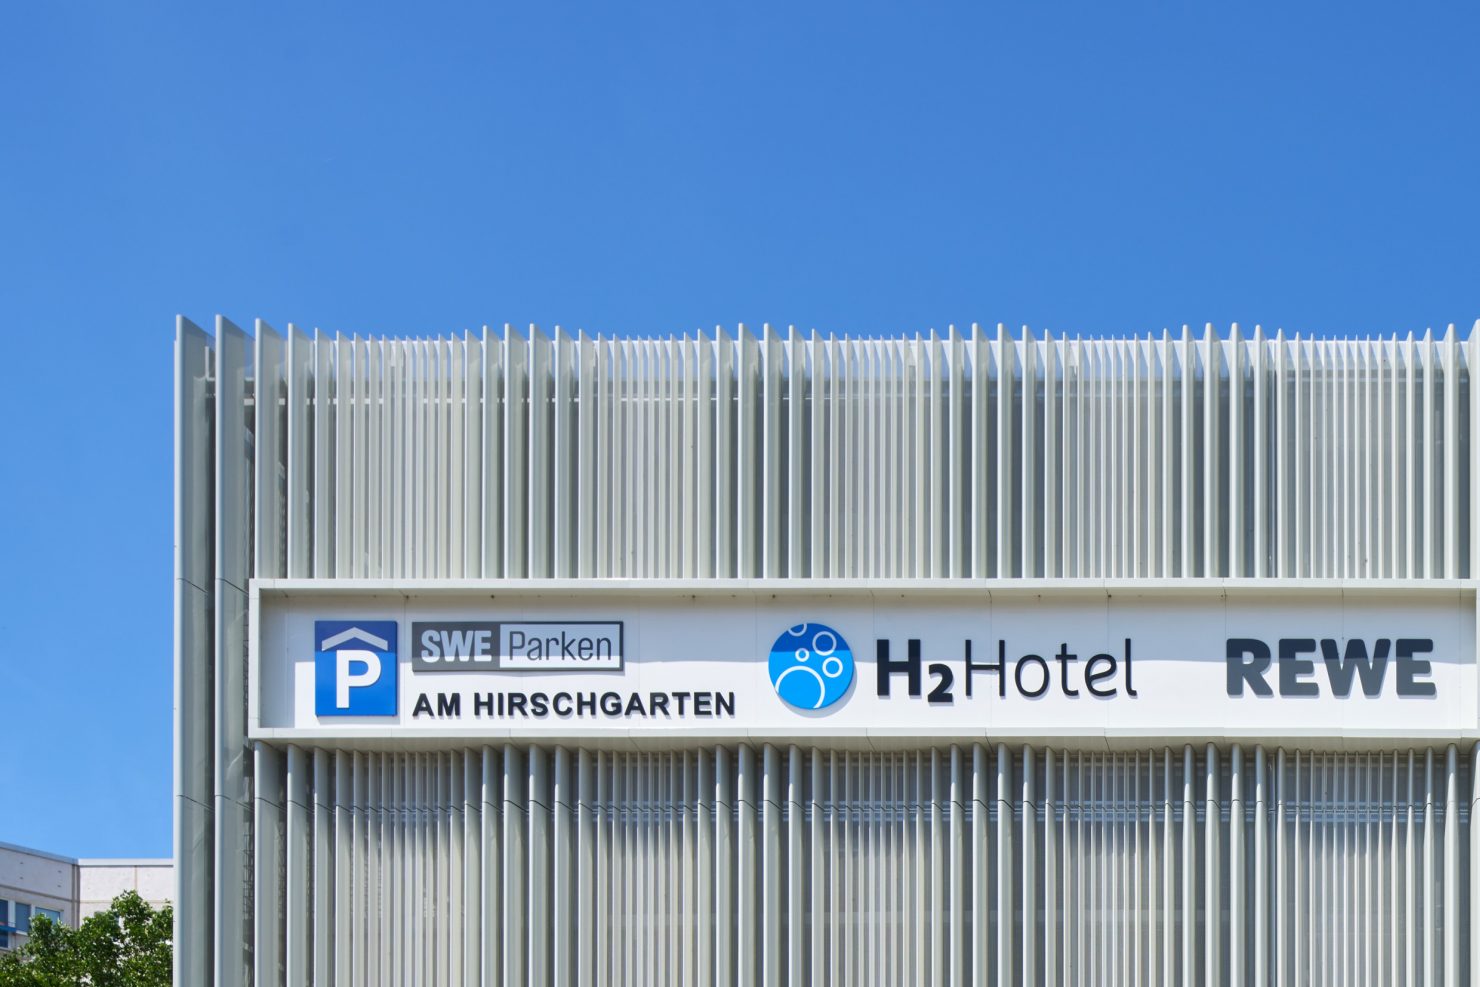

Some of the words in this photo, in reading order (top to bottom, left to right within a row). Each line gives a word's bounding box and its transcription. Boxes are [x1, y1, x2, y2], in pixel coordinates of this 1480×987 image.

[421, 630, 492, 664] SWE
[508, 630, 612, 662] Parken
[1225, 638, 1437, 697] REWE
[336, 649, 382, 709] P
[412, 692, 461, 717] AM
[473, 691, 736, 717] HIRSCHGARTEN
